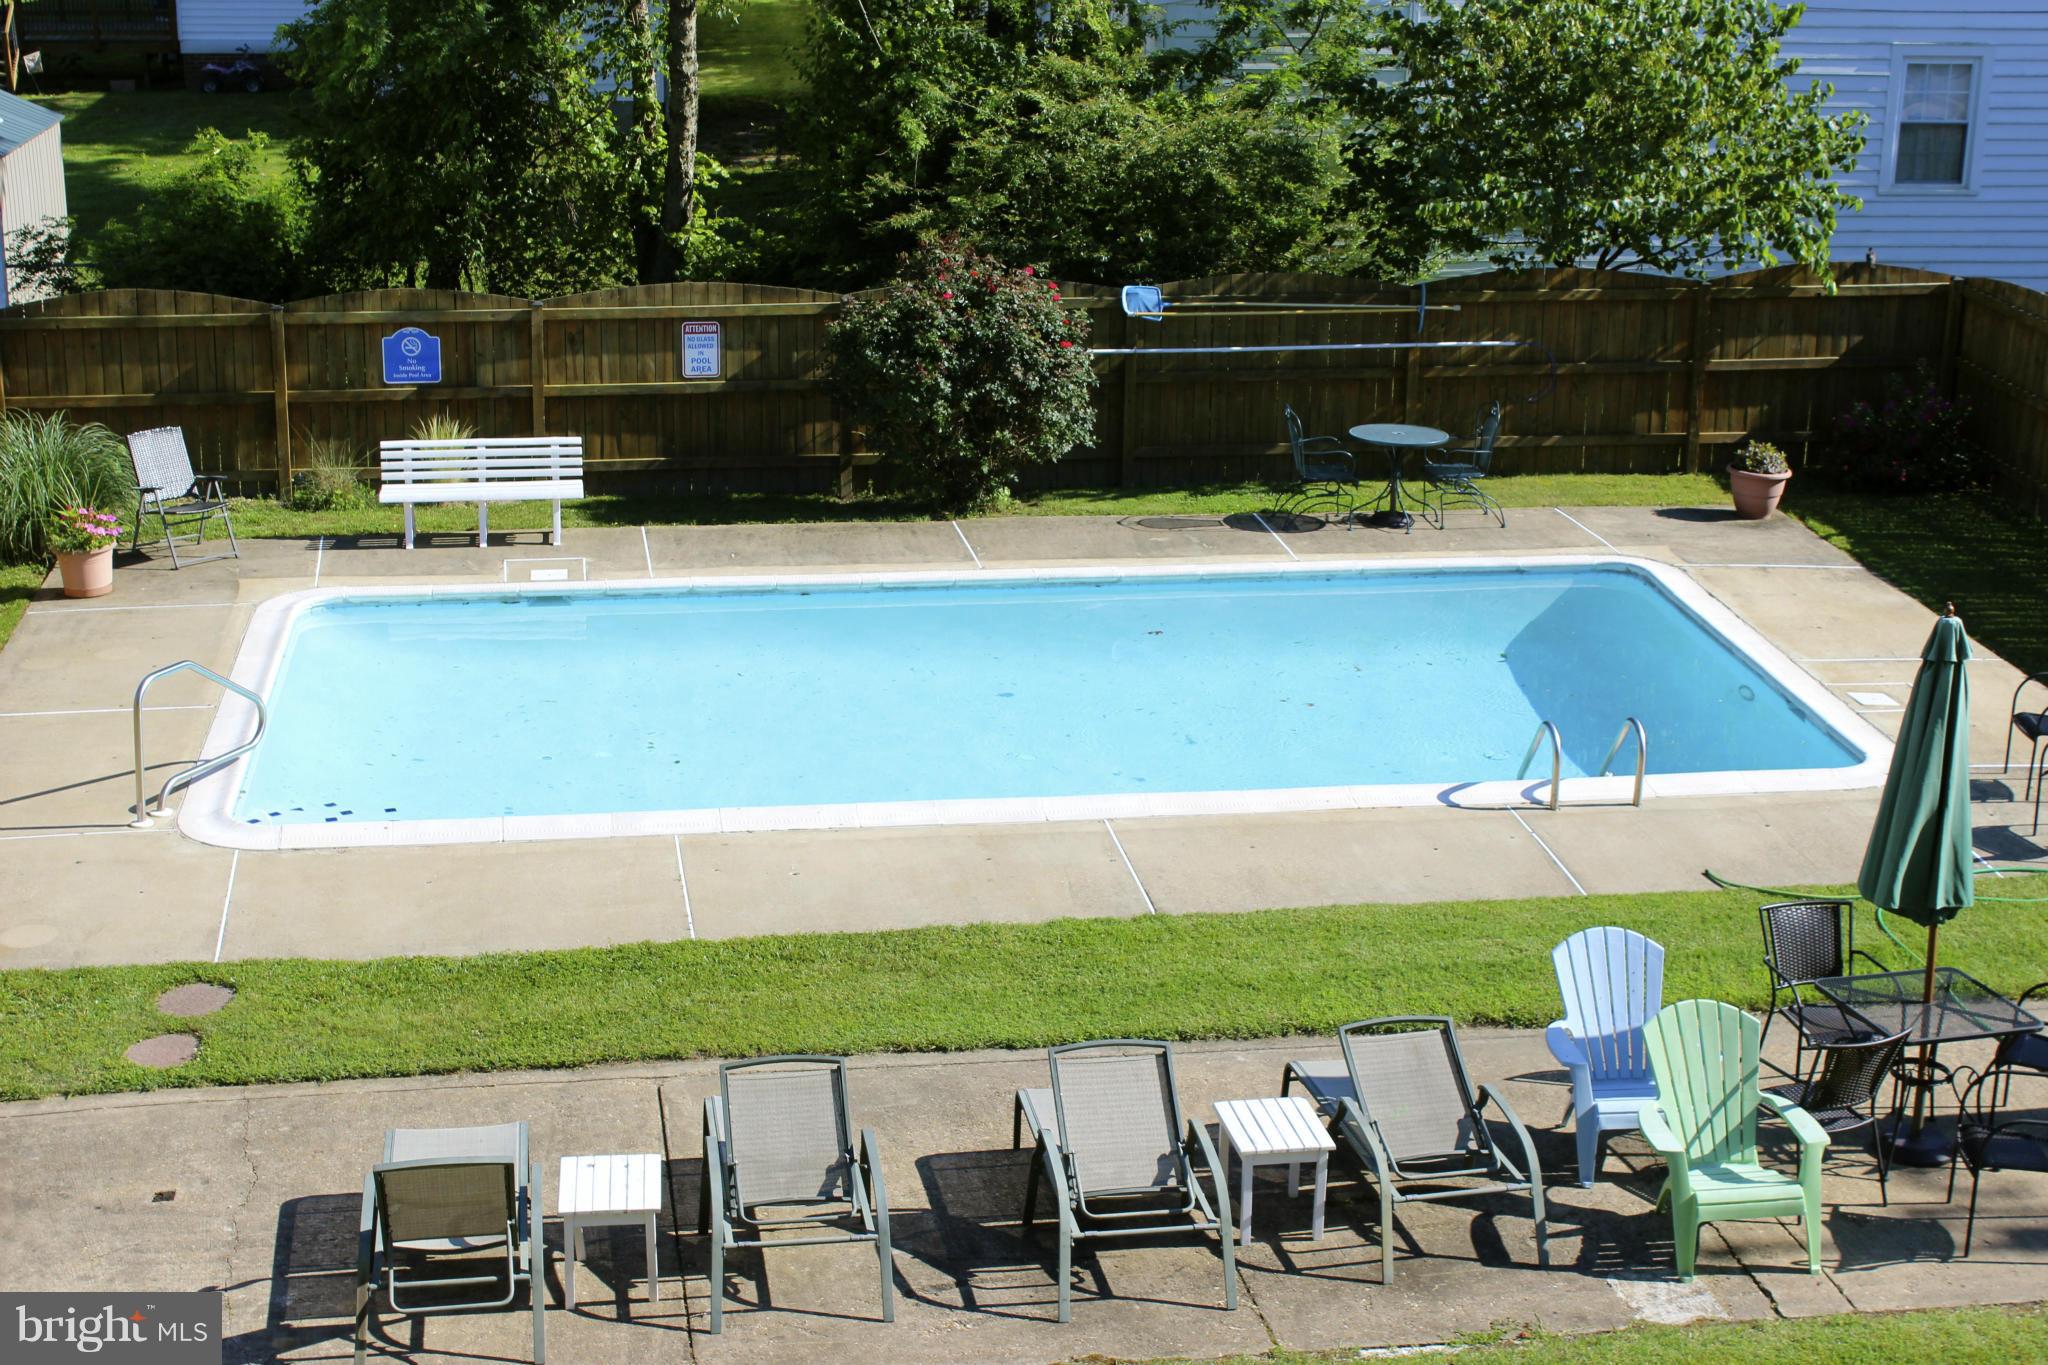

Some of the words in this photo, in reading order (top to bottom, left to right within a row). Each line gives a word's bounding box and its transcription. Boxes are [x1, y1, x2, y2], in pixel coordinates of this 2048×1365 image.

[685, 325, 717, 333] ATTENTION
[398, 364, 426, 373] Smoking
[690, 365, 712, 373] AREA
